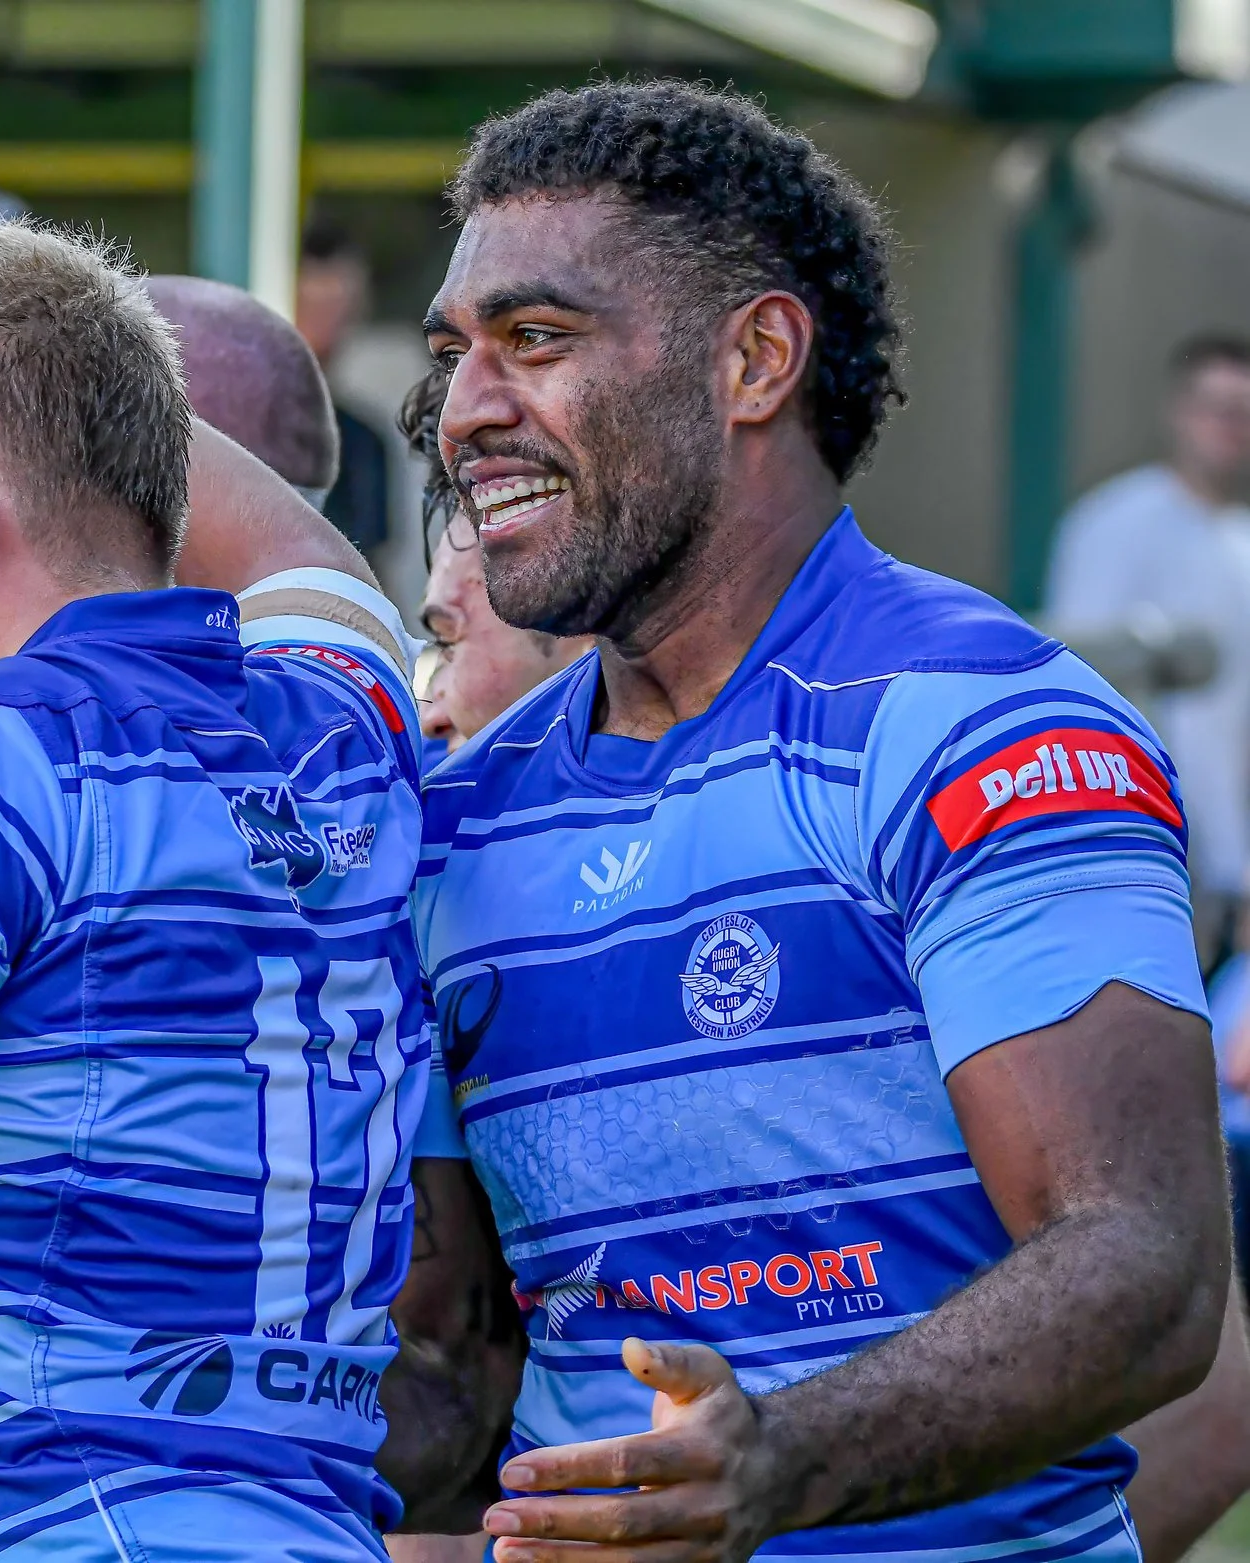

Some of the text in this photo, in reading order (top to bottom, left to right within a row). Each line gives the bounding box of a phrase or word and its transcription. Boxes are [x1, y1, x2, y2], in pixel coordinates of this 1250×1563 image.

[205, 606, 231, 630] est.
[573, 876, 644, 914] PALADIN
[701, 914, 756, 942] COTTESLOE
[711, 944, 741, 962] RUGBY
[712, 956, 741, 973] UNION
[714, 996, 741, 1011] CLUB
[686, 996, 775, 1038] WESTERN AUSTRALIA
[795, 1292, 884, 1321] PTY LTD
